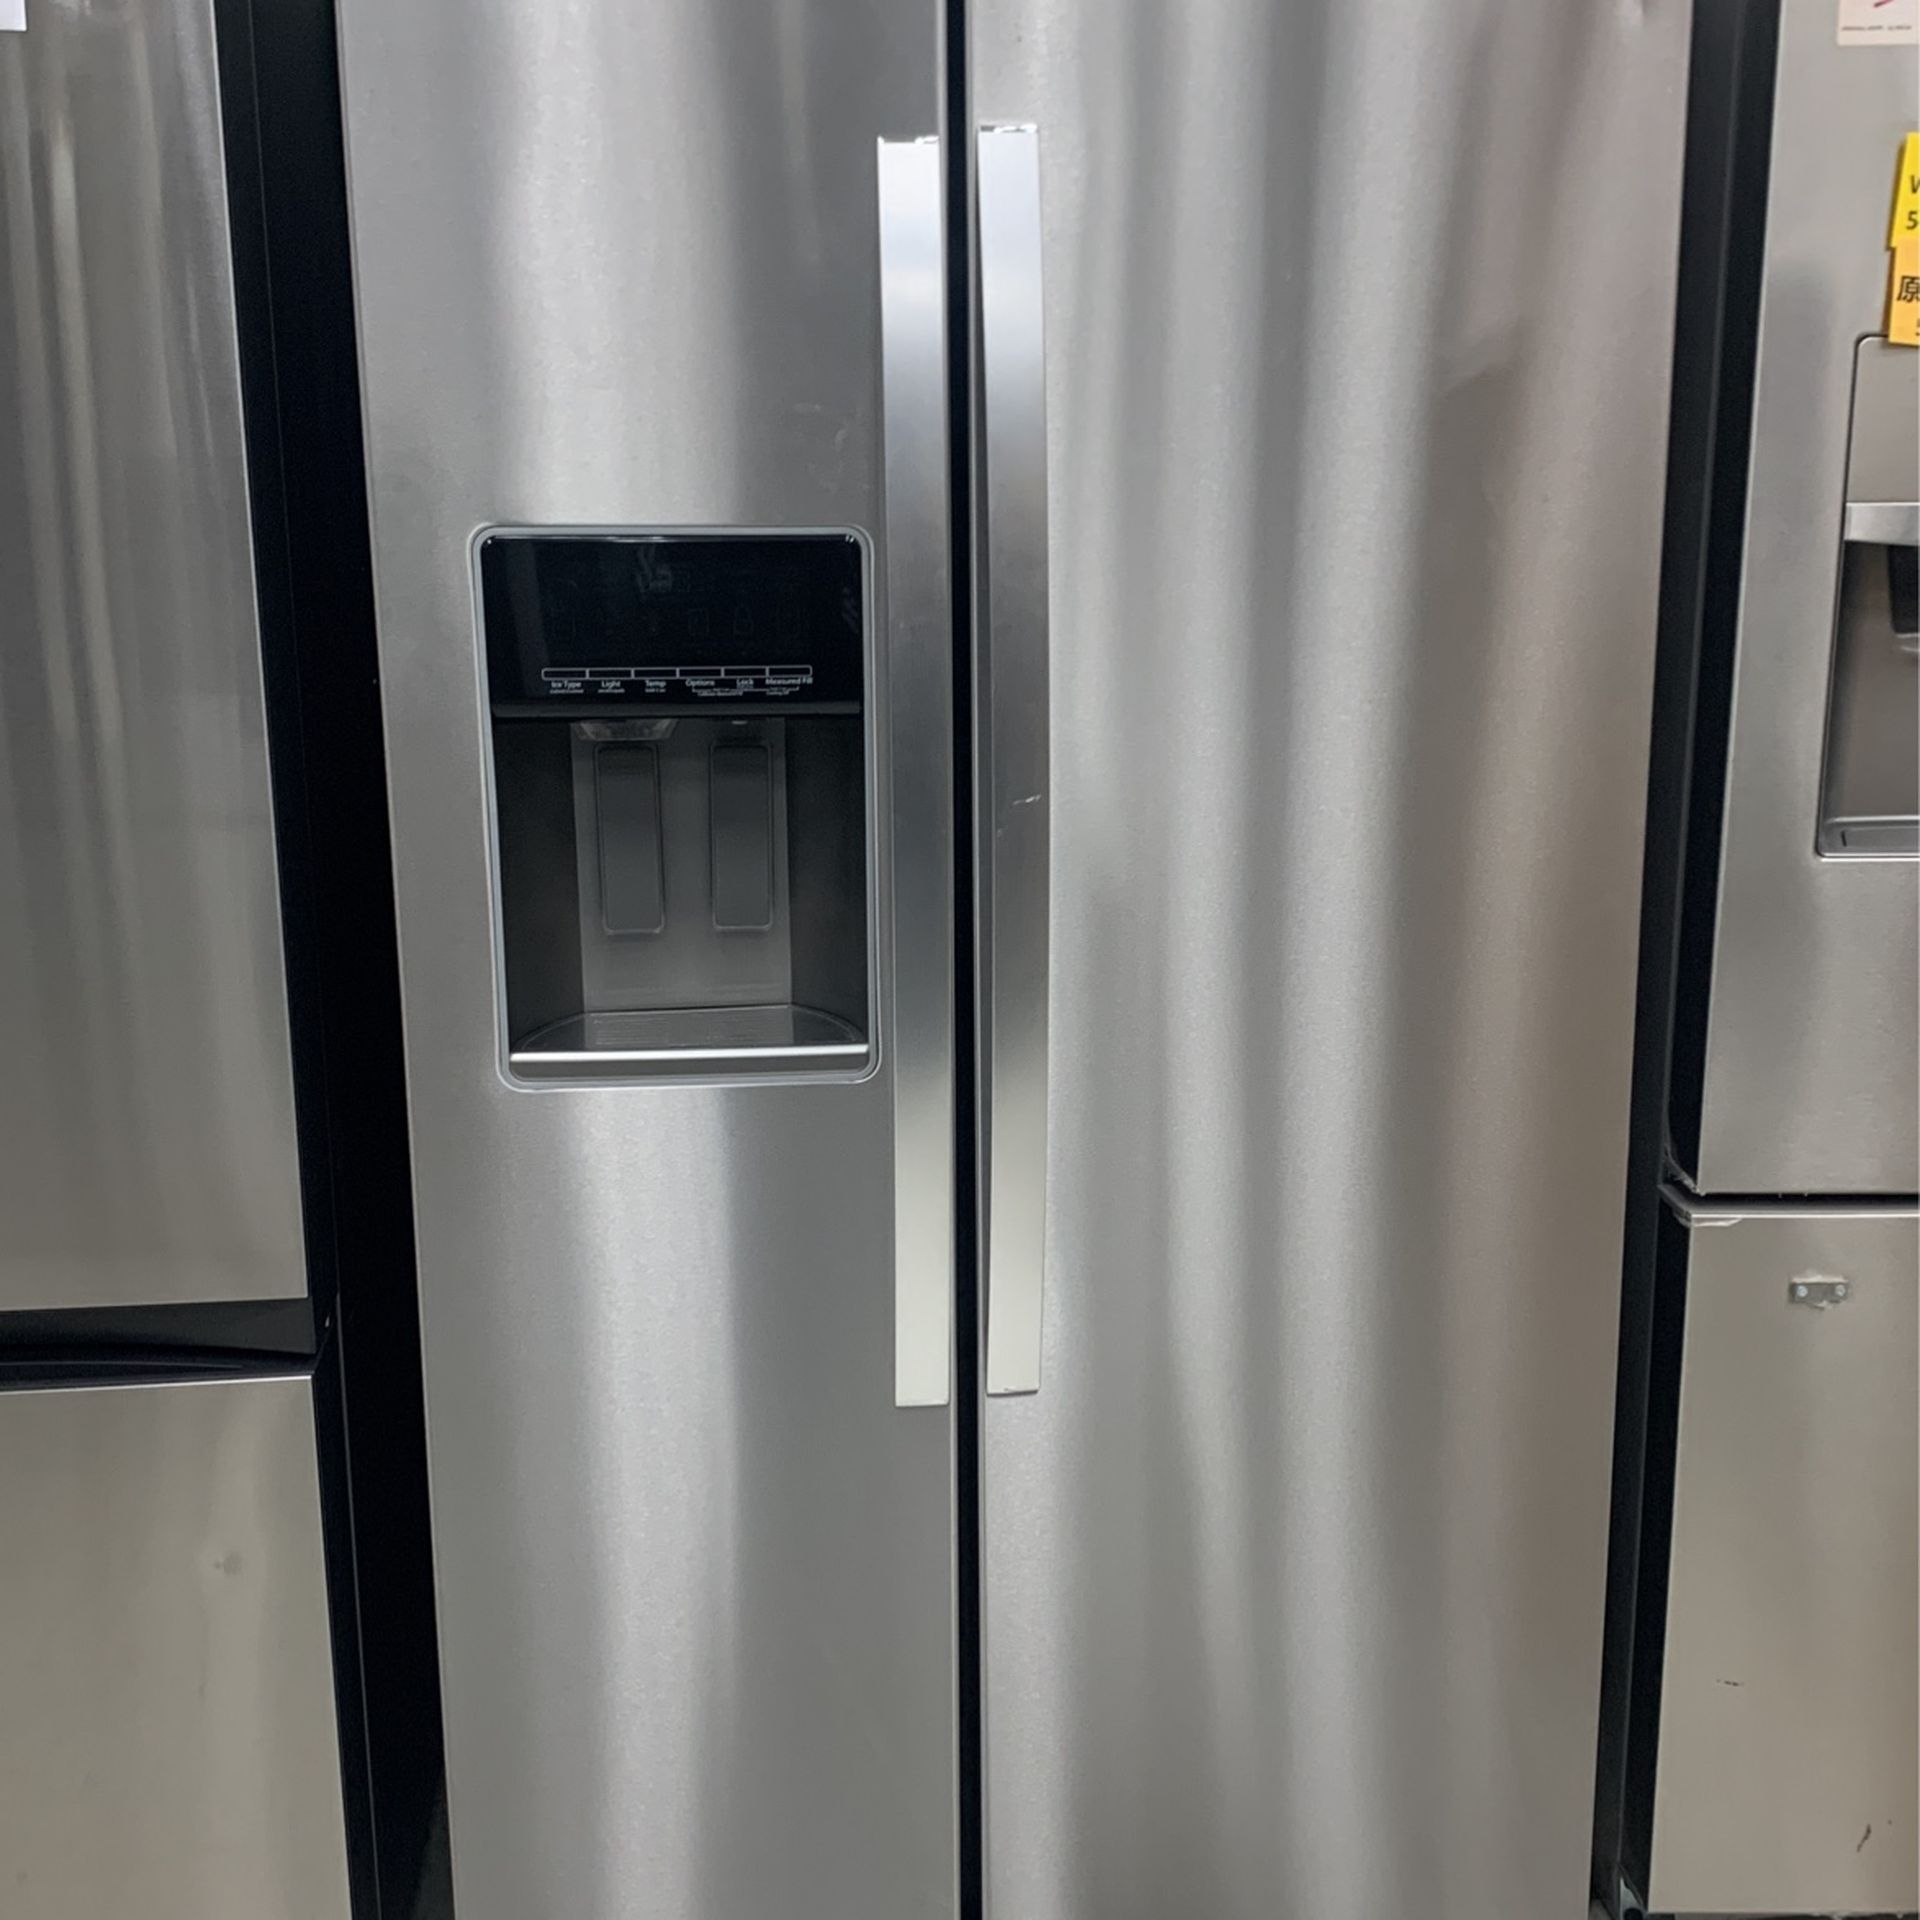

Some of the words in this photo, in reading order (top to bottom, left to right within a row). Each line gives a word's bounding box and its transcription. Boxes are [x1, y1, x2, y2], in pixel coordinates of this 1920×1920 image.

[551, 680, 562, 688] Ice
[564, 680, 582, 690] Type
[601, 680, 621, 690] Light
[645, 680, 666, 688] Temp
[685, 679, 715, 687] Options
[802, 677, 813, 685] Fill
